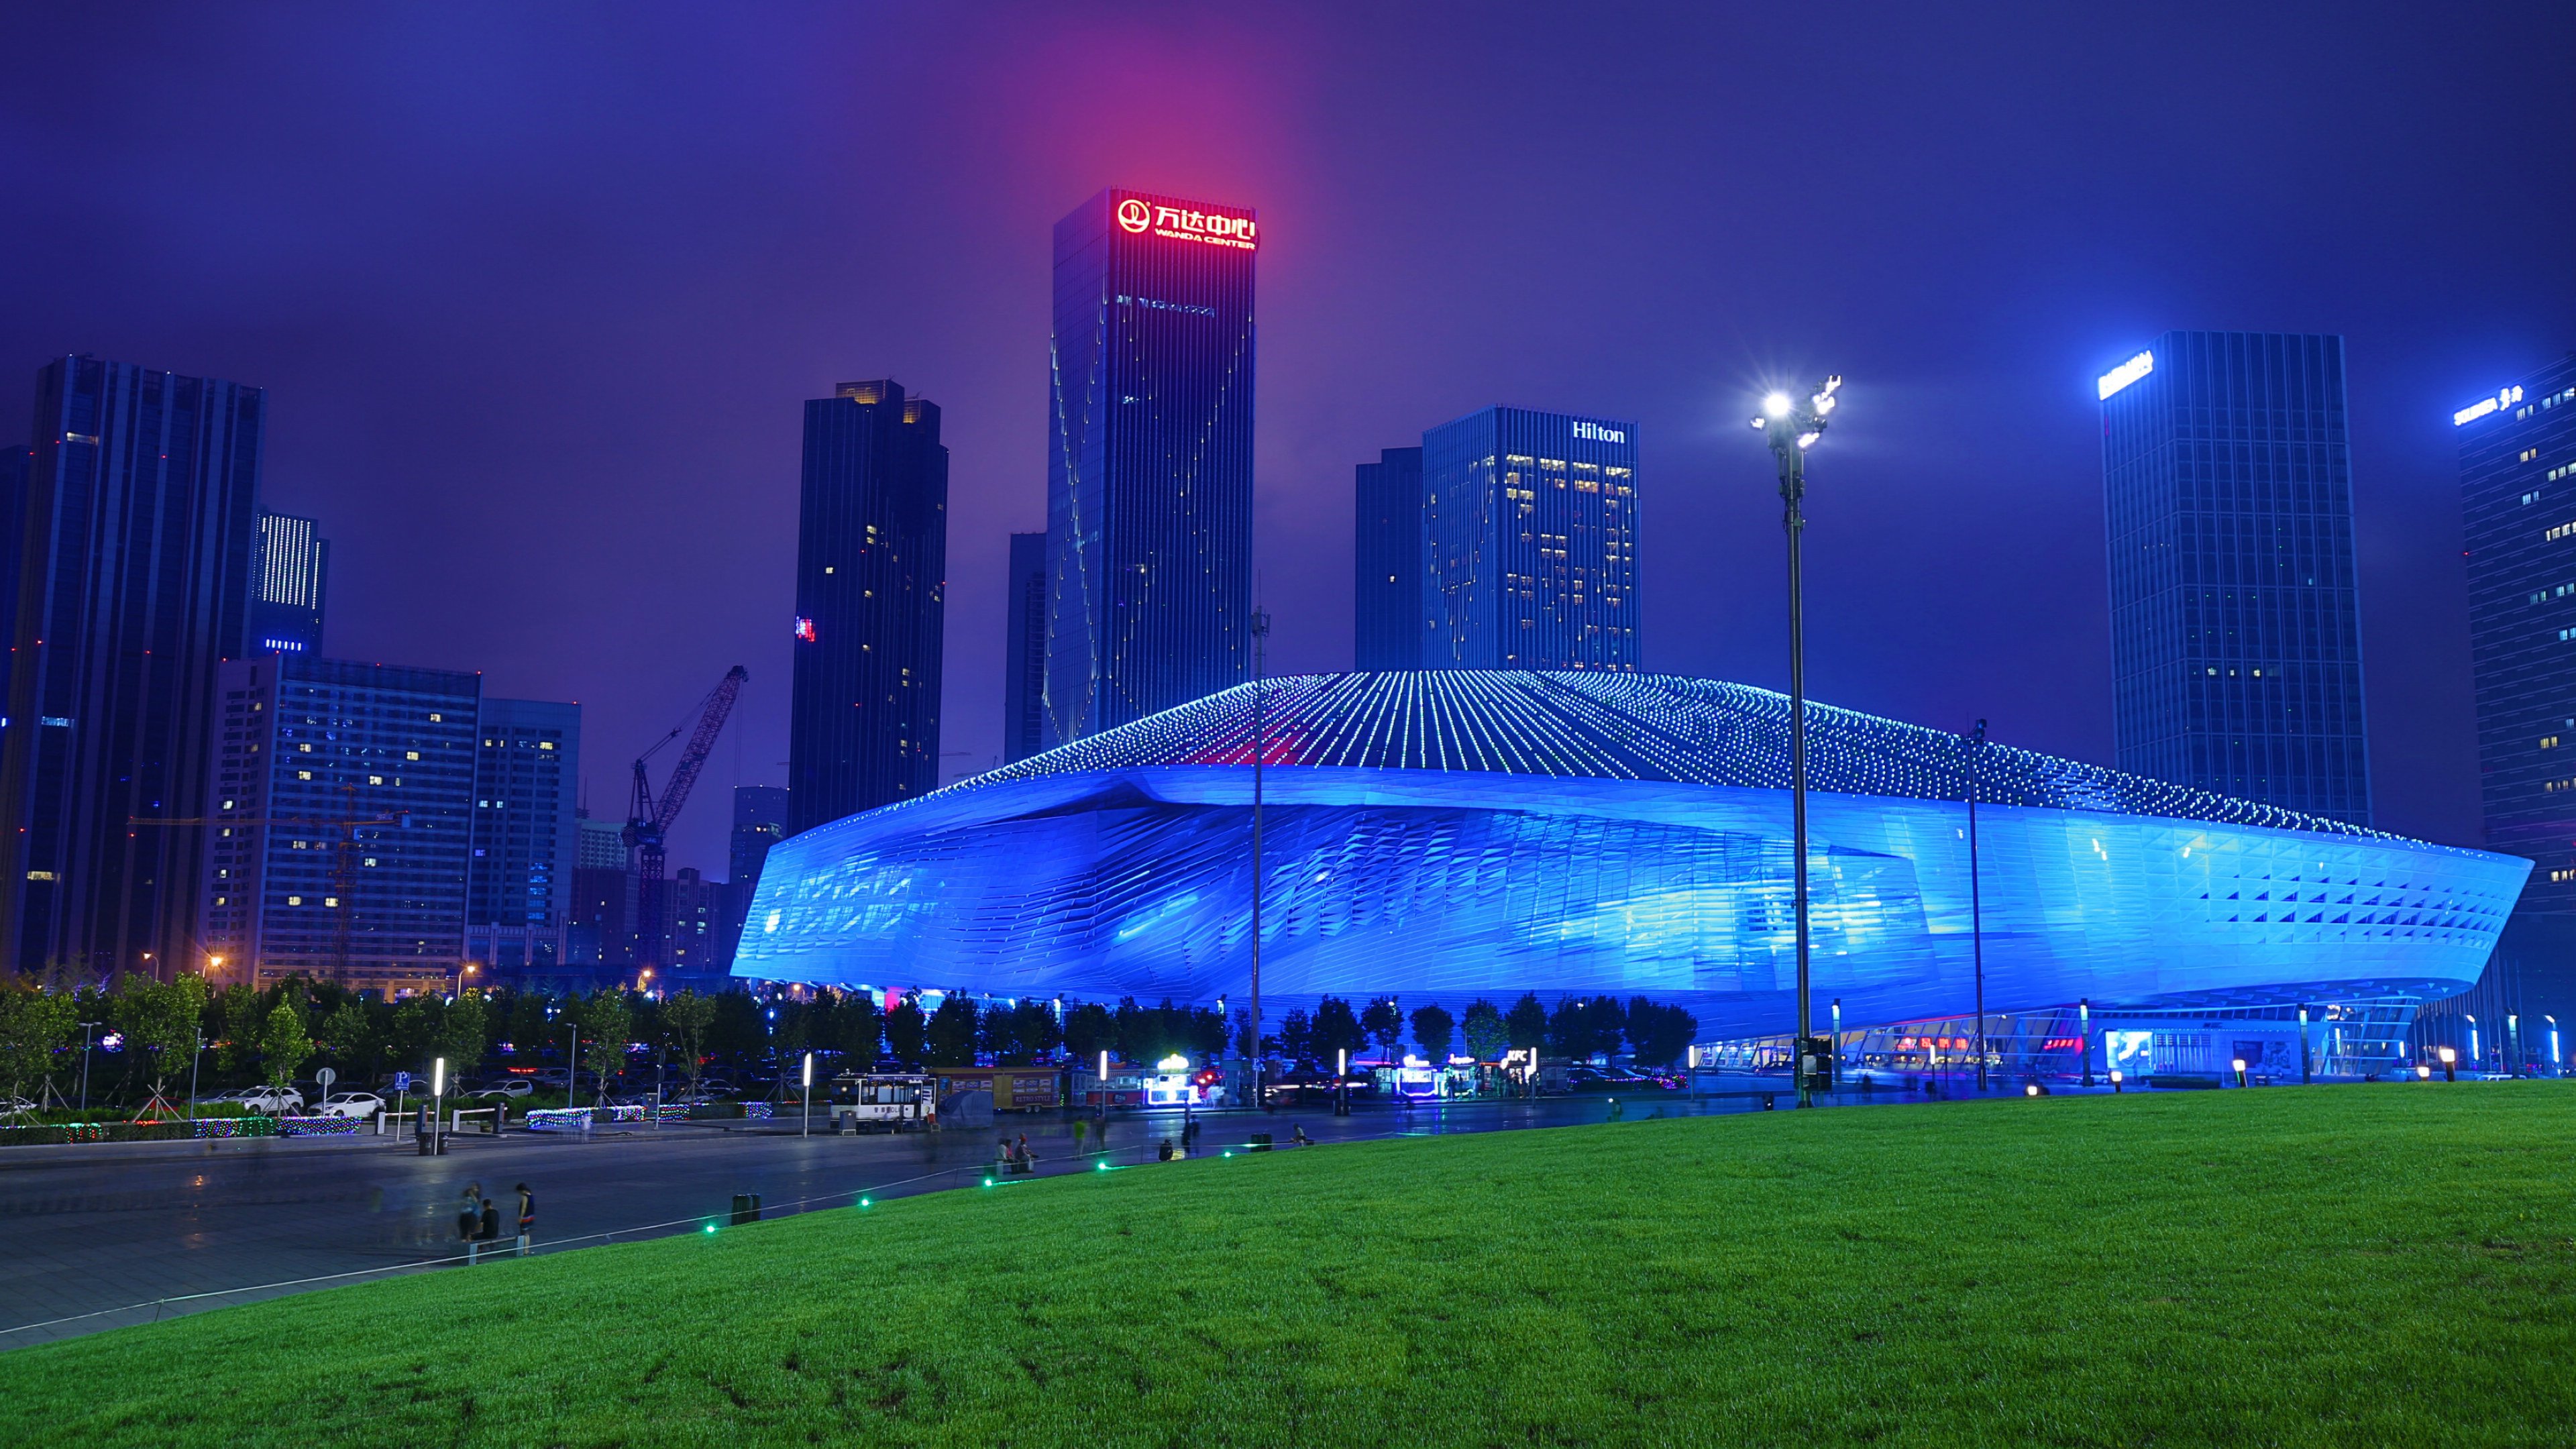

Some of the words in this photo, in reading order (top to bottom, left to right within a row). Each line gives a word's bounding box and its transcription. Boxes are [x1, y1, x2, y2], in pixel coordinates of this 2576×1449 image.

[1155, 206, 1255, 239] 万达中心
[1155, 228, 1202, 241] WANDA
[1203, 235, 1256, 250] CENTER
[1573, 421, 1625, 443] Hilton
[1507, 1050, 1527, 1061] KFC
[398, 1073, 408, 1083] P
